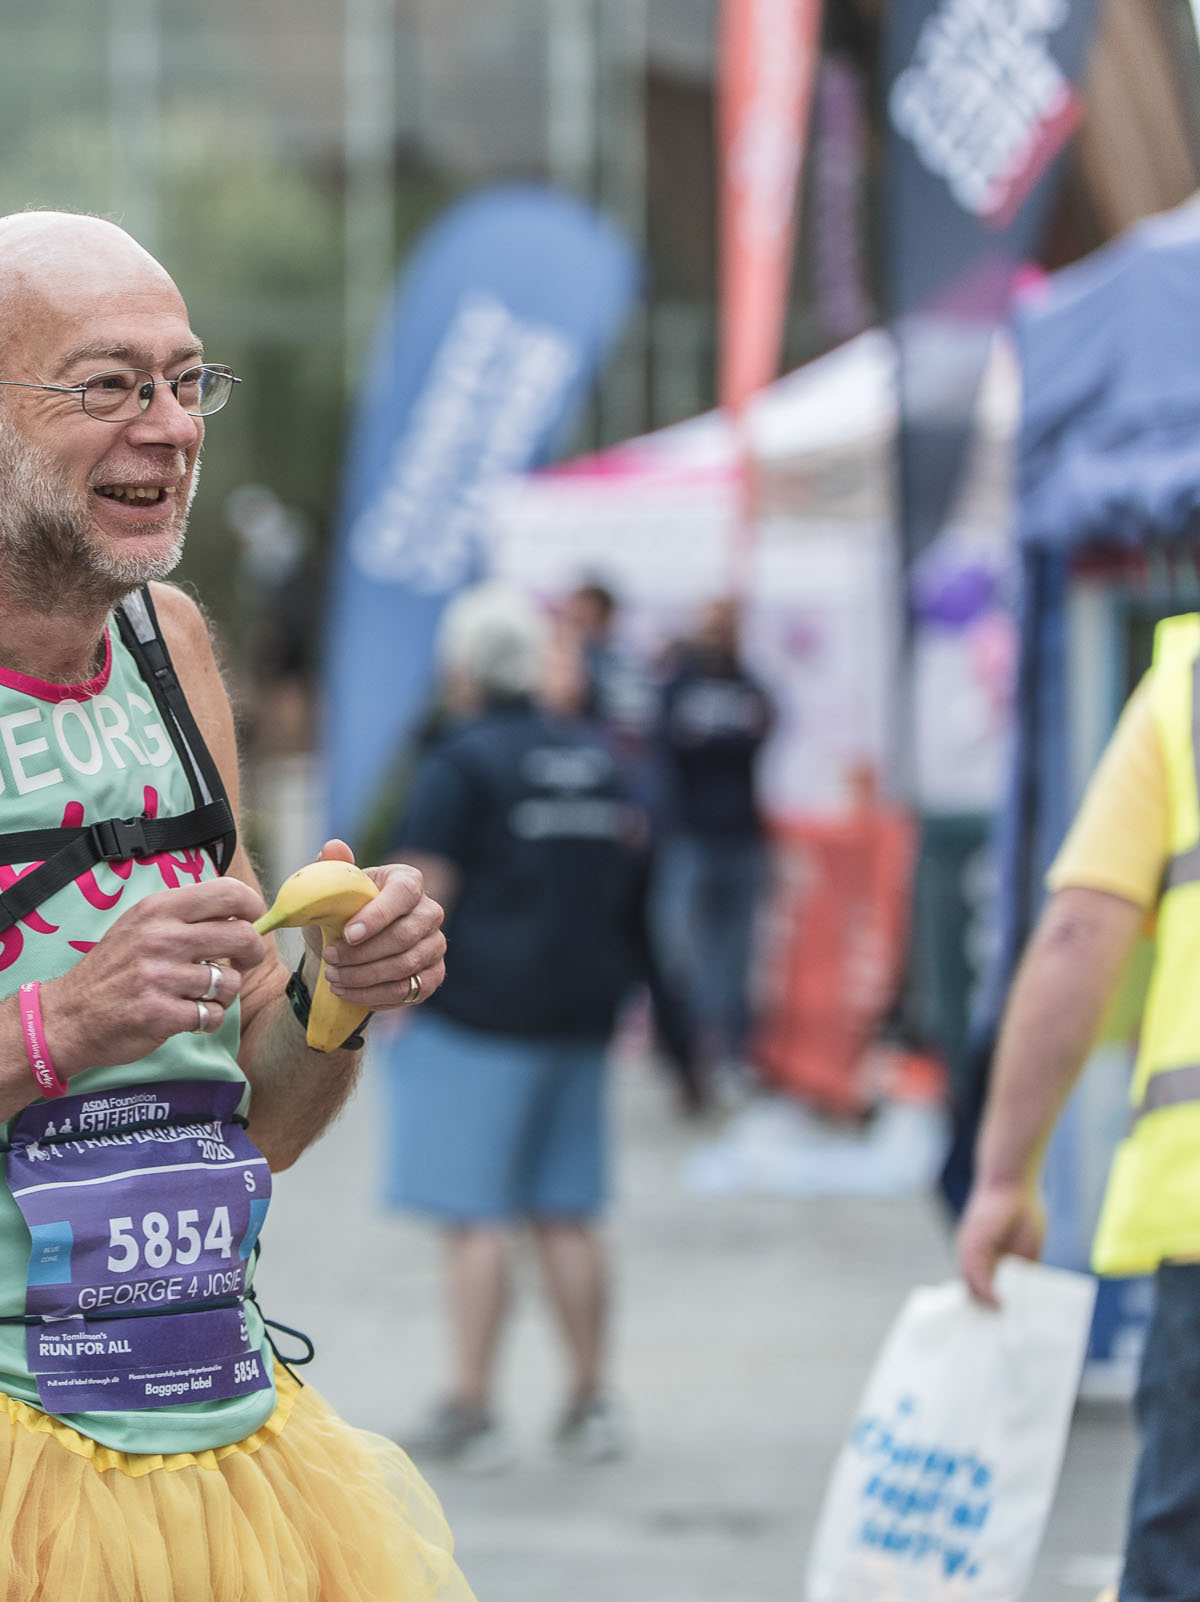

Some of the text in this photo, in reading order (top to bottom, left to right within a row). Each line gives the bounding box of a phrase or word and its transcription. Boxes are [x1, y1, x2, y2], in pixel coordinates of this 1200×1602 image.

[82, 1094, 157, 1113] ASDA Foundation
[197, 1139, 235, 1160] 2020
[243, 1171, 256, 1192] S
[107, 1206, 233, 1273] 5854
[78, 1268, 242, 1310] GEORGE 4 JOSIE
[39, 1333, 60, 1342] Jane
[39, 1340, 132, 1356] RUN FOR ALL
[234, 1358, 260, 1384] 5854
[145, 1375, 212, 1397] Baggage label
